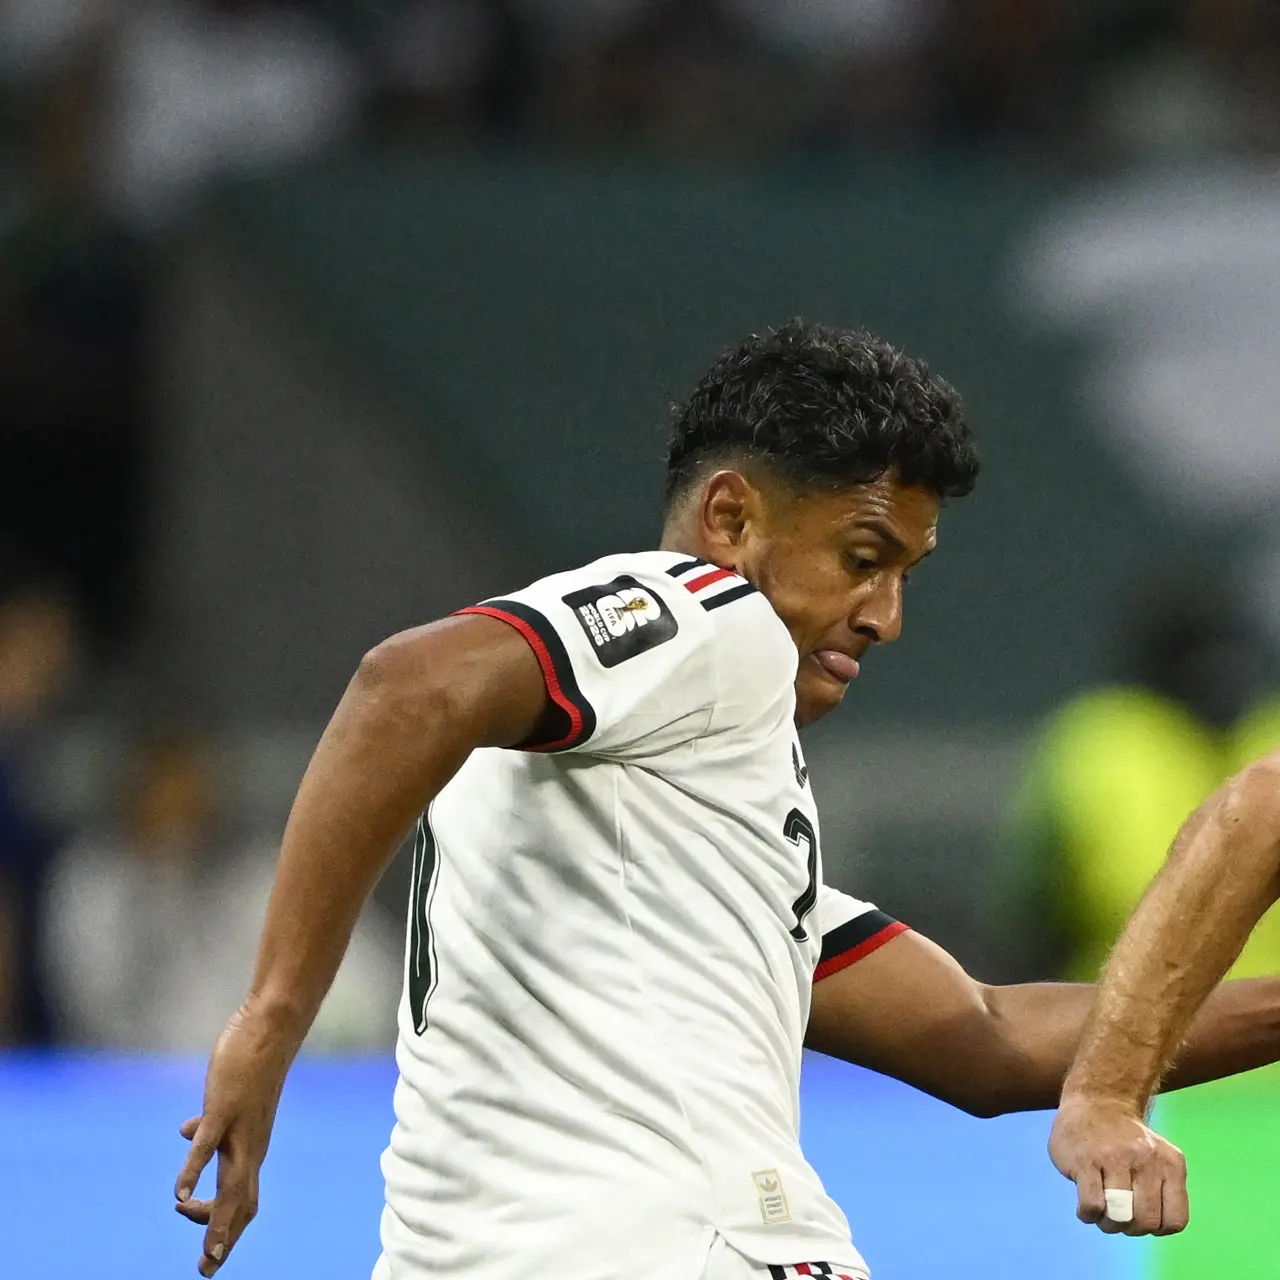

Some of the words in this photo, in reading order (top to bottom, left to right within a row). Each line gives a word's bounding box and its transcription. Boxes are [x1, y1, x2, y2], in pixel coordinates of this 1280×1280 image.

[578, 605, 604, 647] 2026
[587, 602, 604, 628] WORLD
[600, 627, 611, 642] CUP
[605, 607, 617, 626] FIFA
